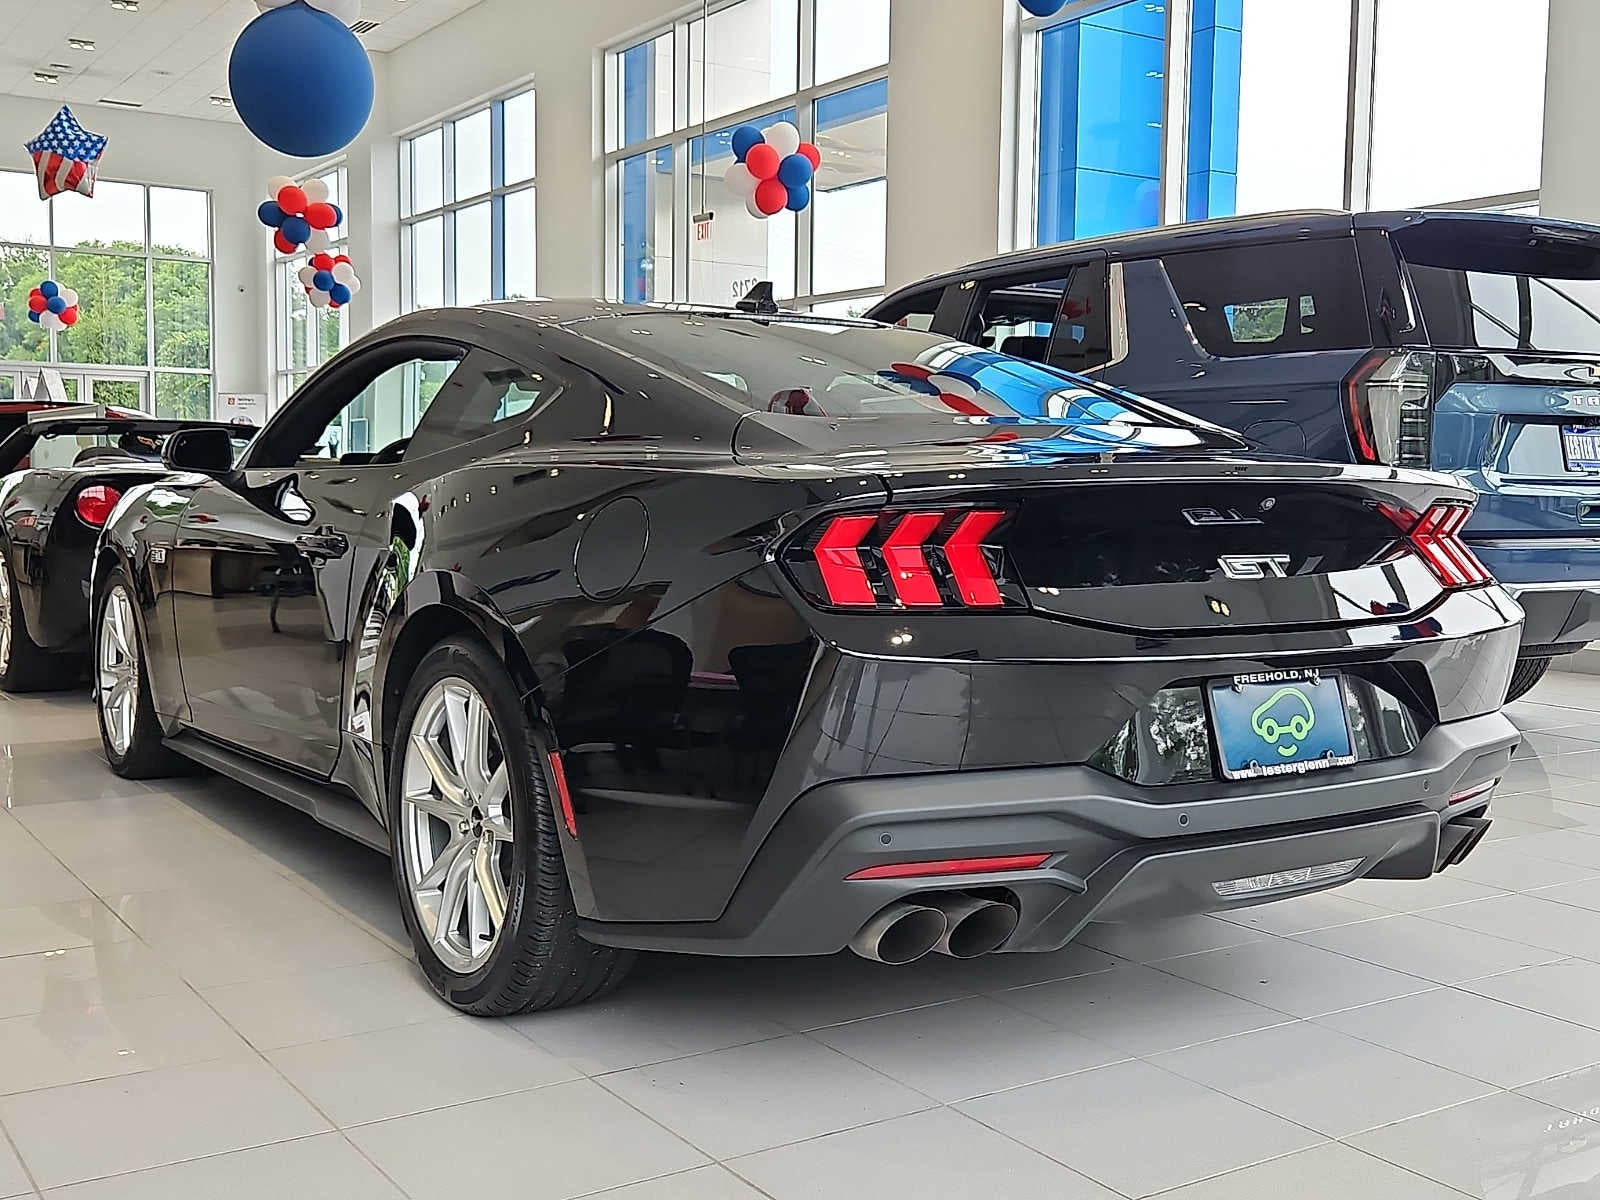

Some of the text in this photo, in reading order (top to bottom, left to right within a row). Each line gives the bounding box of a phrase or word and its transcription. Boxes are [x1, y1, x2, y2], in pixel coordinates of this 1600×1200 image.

[697, 222, 711, 240] EXIT
[1217, 554, 1291, 579] GT
[1233, 668, 1320, 684] FREEHOLD, NJ
